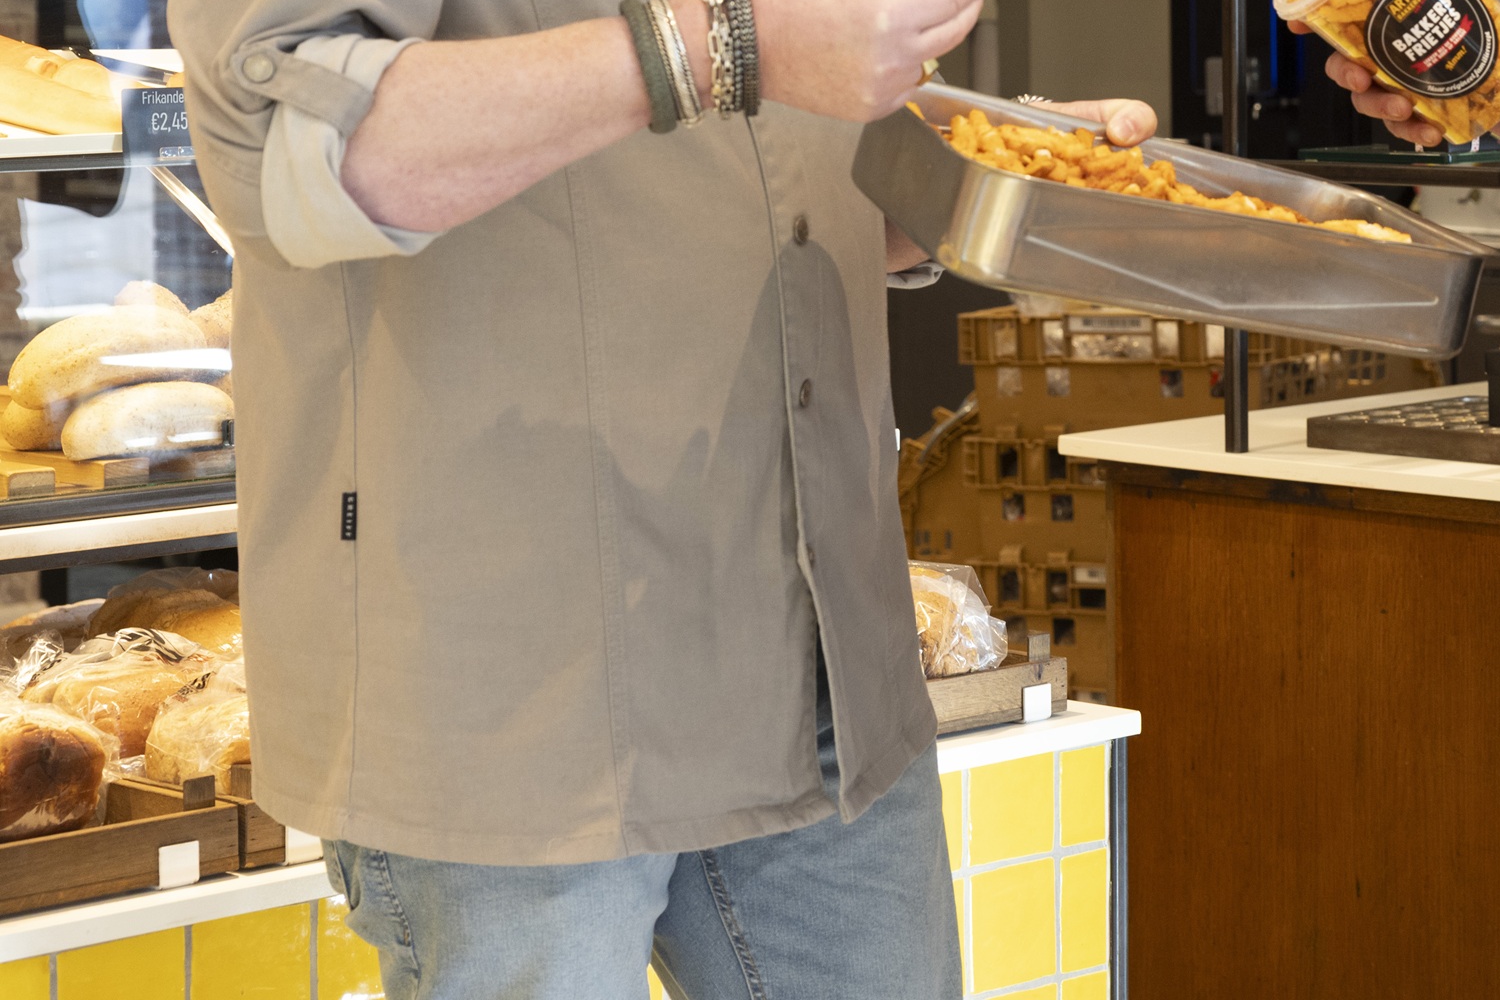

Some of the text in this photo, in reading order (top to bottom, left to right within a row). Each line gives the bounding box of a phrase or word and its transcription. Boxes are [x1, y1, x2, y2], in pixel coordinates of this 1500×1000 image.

[1404, 7, 1461, 62] FRIETJES
[142, 90, 184, 105] Frikande
[151, 112, 188, 132] €2,45
